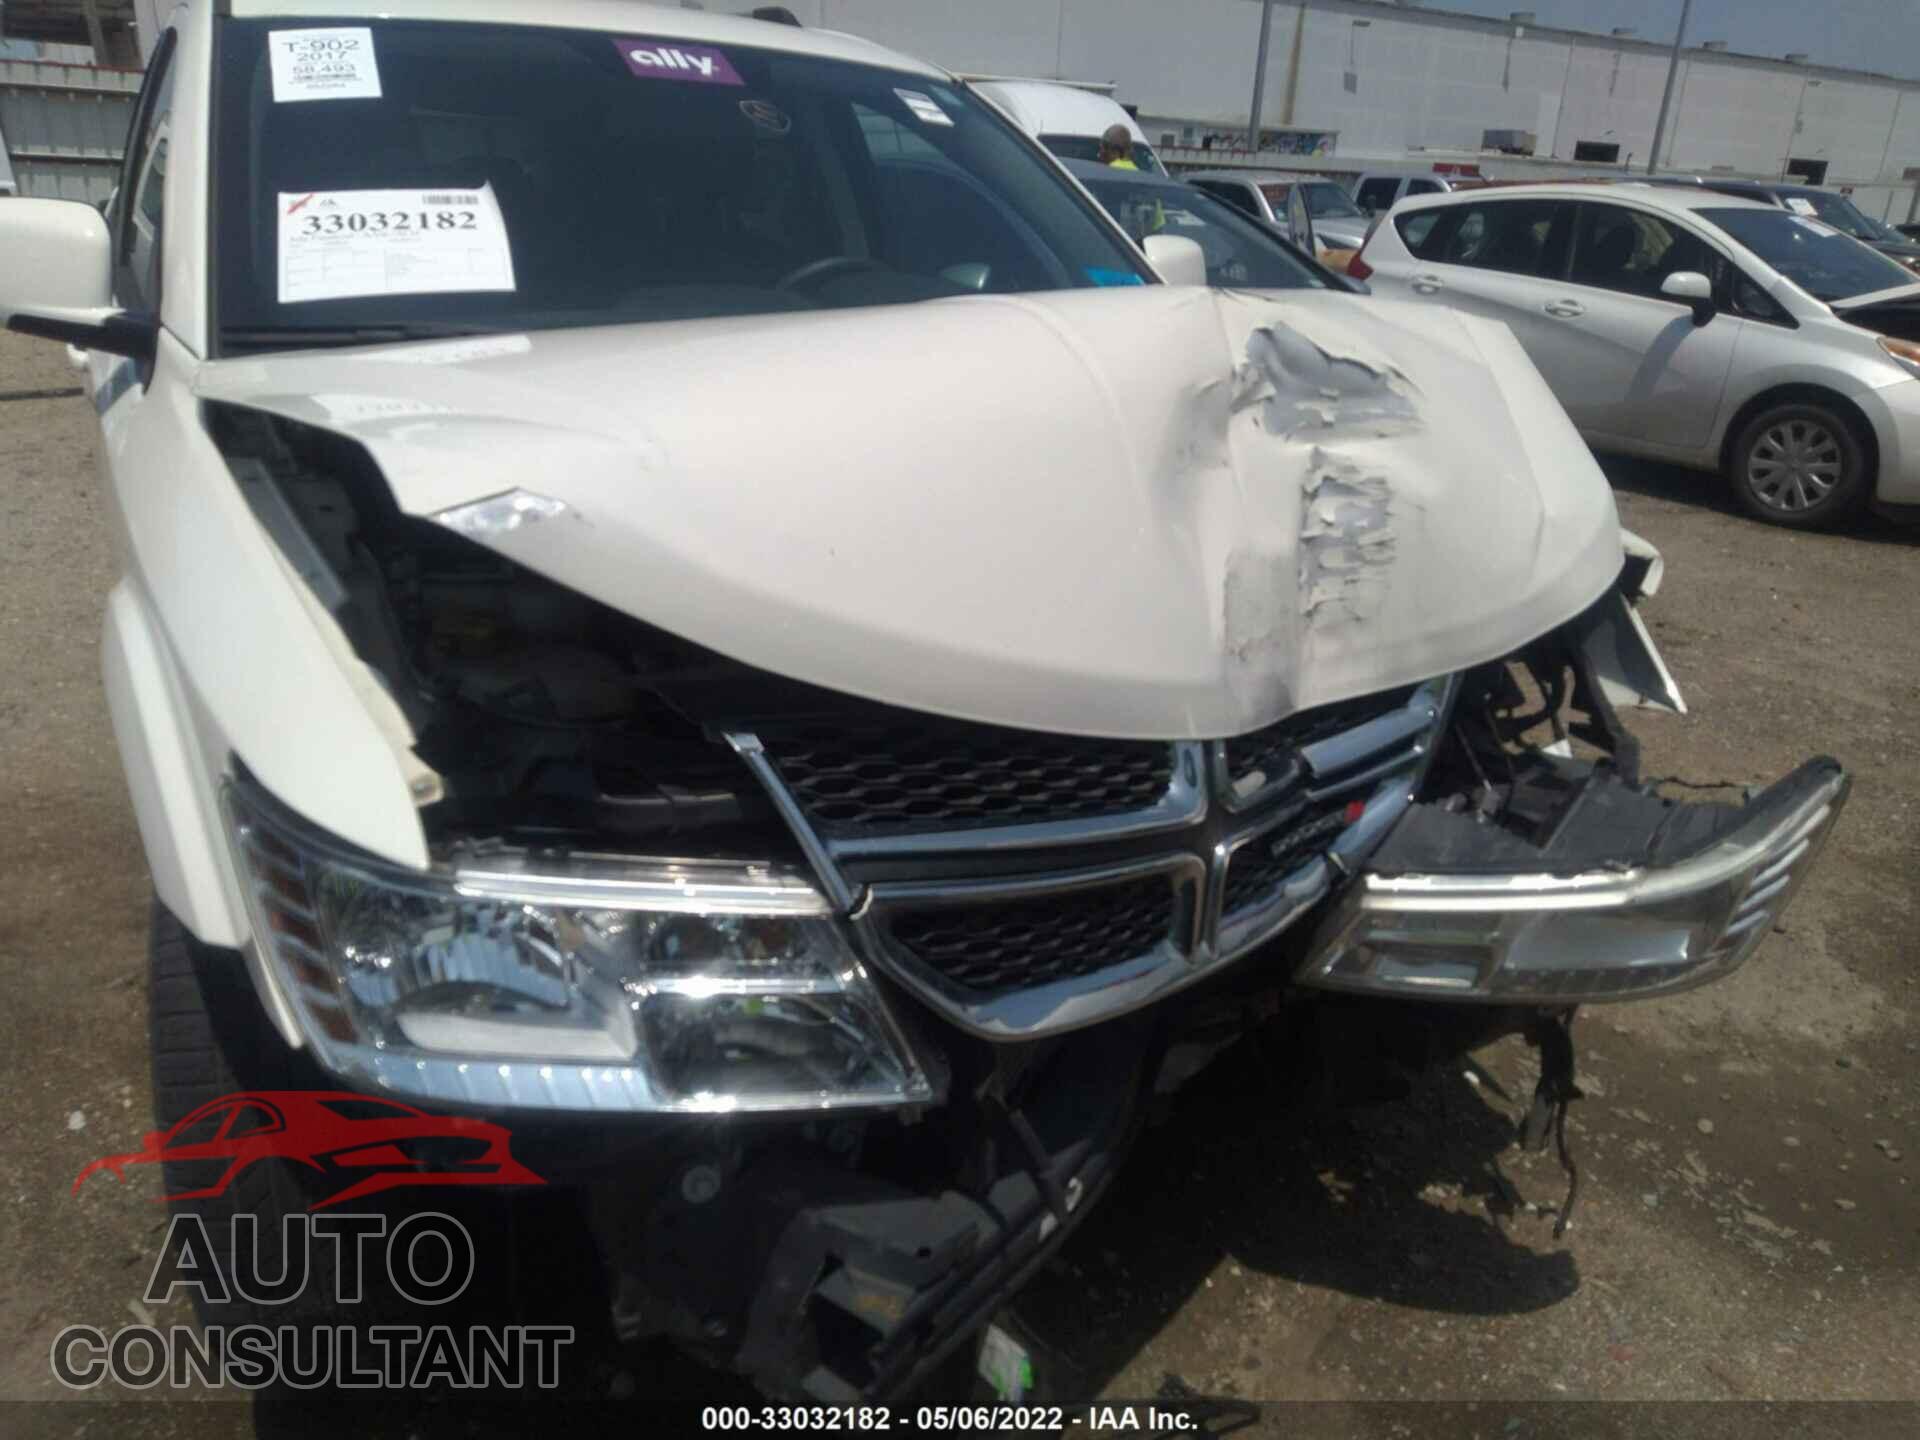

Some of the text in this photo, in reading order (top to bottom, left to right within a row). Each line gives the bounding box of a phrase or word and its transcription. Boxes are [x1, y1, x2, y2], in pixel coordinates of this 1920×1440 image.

[281, 39, 361, 52] T-902
[629, 48, 713, 76] ally
[302, 211, 477, 236] 33032182
